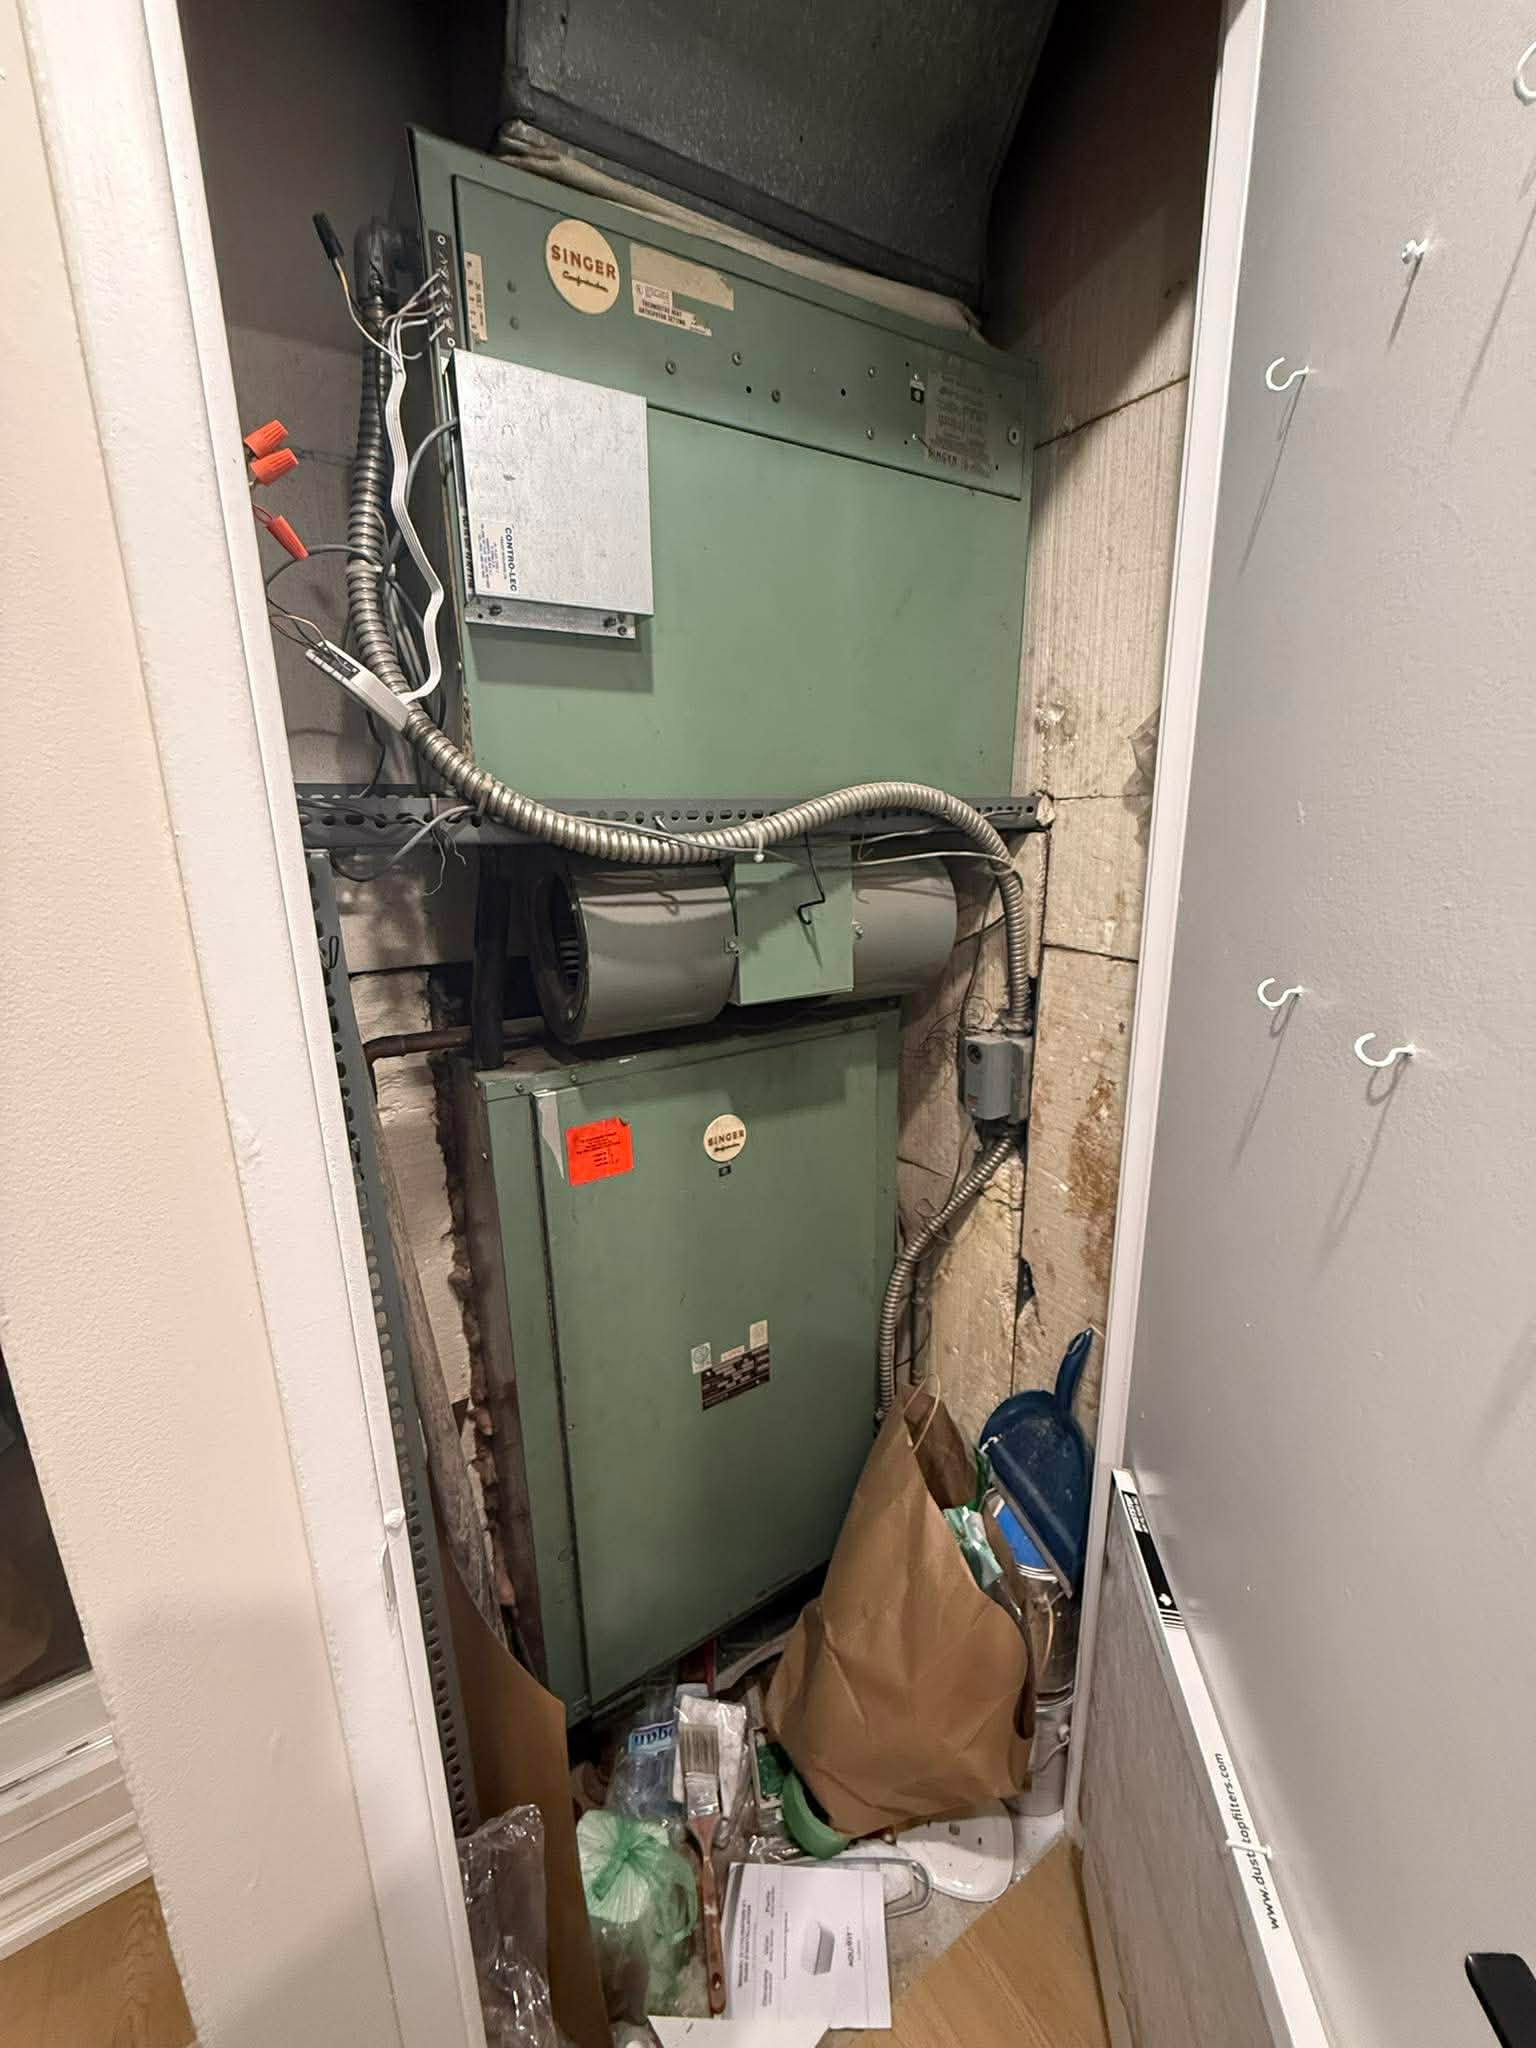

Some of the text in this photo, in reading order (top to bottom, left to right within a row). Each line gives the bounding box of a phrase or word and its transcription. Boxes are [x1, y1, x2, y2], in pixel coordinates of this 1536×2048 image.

[551, 244, 616, 280] SINGER
[504, 527, 517, 592] CONTRO-LEC
[707, 1129, 745, 1146] SINGER
[1214, 1752, 1280, 1931] www.dusttopfilters.com
